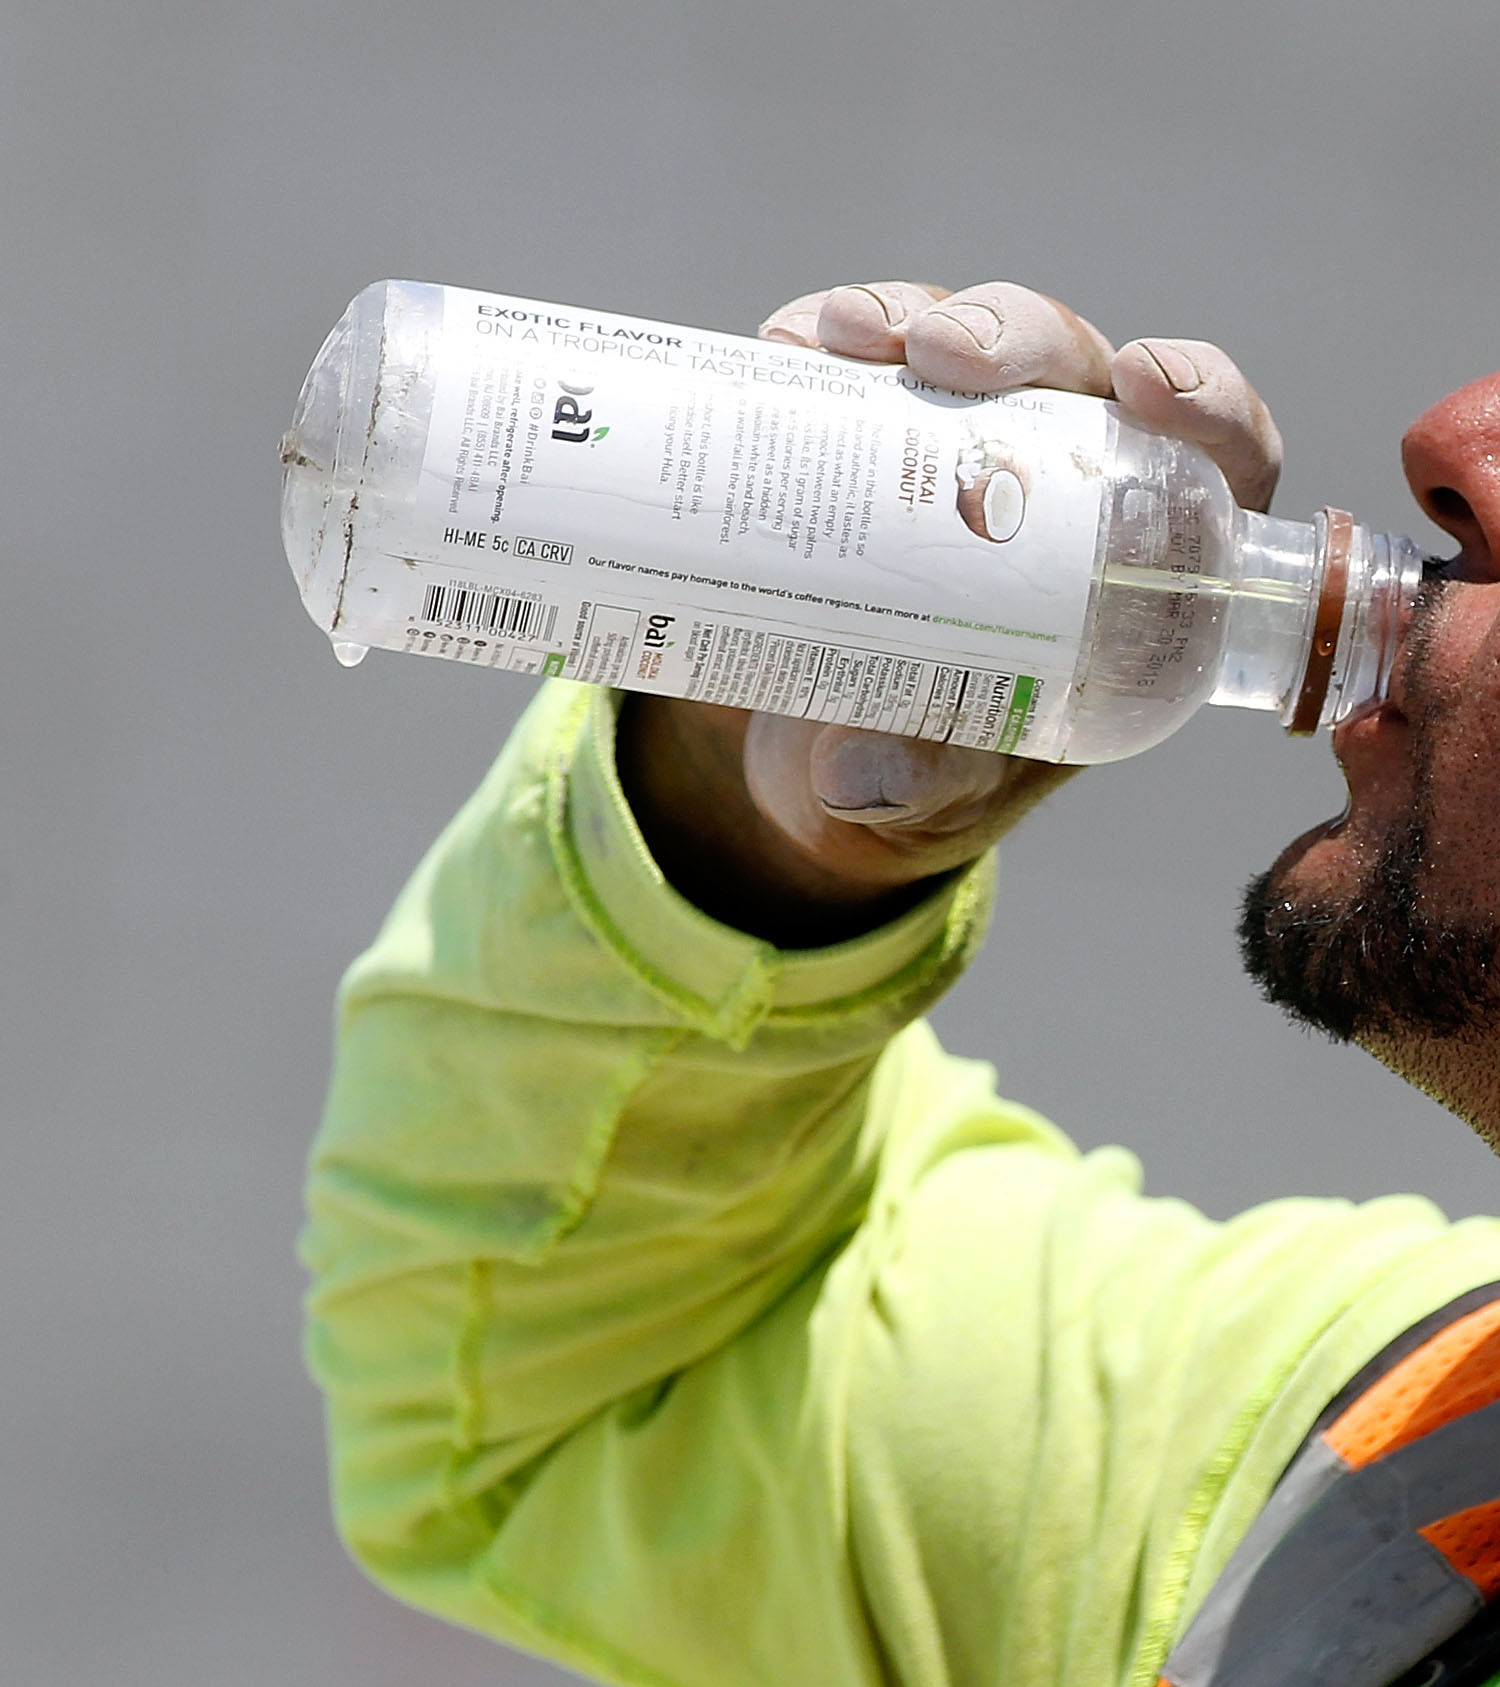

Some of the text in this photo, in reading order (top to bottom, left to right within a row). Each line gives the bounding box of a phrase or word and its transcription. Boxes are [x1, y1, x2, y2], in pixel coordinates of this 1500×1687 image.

[476, 320, 866, 399] ON A TROPICAL TASTECATION
[478, 305, 571, 329] EXOTIC
[579, 322, 682, 348] FLAVOR
[696, 341, 758, 363] THAT
[768, 354, 860, 380] SENDS
[868, 372, 937, 393] YOUR
[490, 420, 502, 449] Brands
[502, 407, 519, 459] refrigerate
[698, 431, 711, 450] this
[730, 415, 747, 459] waterfall
[765, 432, 779, 462] sweet
[454, 448, 468, 474] Rights
[487, 450, 498, 466] LLC
[519, 422, 539, 484] #DrinkBai
[659, 431, 675, 485] your Hula.
[730, 461, 740, 471] in
[746, 444, 760, 471] white
[781, 432, 795, 470] calories
[499, 459, 511, 483] after
[675, 459, 690, 492] Better
[694, 452, 708, 482] bottle
[727, 472, 739, 489] the
[764, 463, 773, 476] as
[777, 471, 789, 490] per
[845, 452, 861, 500] authentic,
[866, 468, 877, 478] in
[448, 476, 463, 513] Reserved
[692, 483, 703, 493] is
[743, 473, 756, 499] sand
[791, 477, 805, 505] gram
[822, 449, 844, 538] as what an empty
[863, 479, 876, 498] this
[489, 483, 507, 525] opening.
[671, 494, 684, 520] start
[688, 494, 702, 515] like
[718, 491, 736, 545] rainforest.
[737, 500, 753, 536] beach,
[757, 486, 772, 521] hidden
[770, 491, 787, 530] serving
[792, 506, 803, 518] of
[802, 459, 826, 560] between two palms
[845, 501, 854, 509] it
[859, 500, 873, 530] bottle
[784, 519, 799, 551] sugar
[839, 511, 853, 544] tastes
[857, 531, 868, 541] is
[444, 528, 486, 548] HI-ME
[517, 540, 535, 556] CA
[541, 544, 569, 561] CRV
[837, 545, 847, 559] as
[855, 543, 865, 556] so
[578, 601, 591, 619] Good
[588, 556, 1056, 643] Our flavor names pay homage to the world's coffee regions. Learn more at drinkbai.com/flavornames
[644, 612, 677, 650] bai
[702, 628, 711, 638] Net
[805, 644, 820, 676] Vitamin
[822, 647, 837, 678] Protein
[830, 656, 849, 693] Erythritol
[846, 659, 863, 688] Sugars
[865, 654, 878, 675] Total
[891, 659, 906, 691] Sodium
[907, 661, 919, 682] Total
[874, 657, 891, 699] Potassium
[903, 683, 914, 697] Fat
[933, 665, 949, 700] Calories
[947, 668, 962, 700] Amount
[983, 674, 1010, 731] Nutrition
[1028, 678, 1044, 713] Contains
